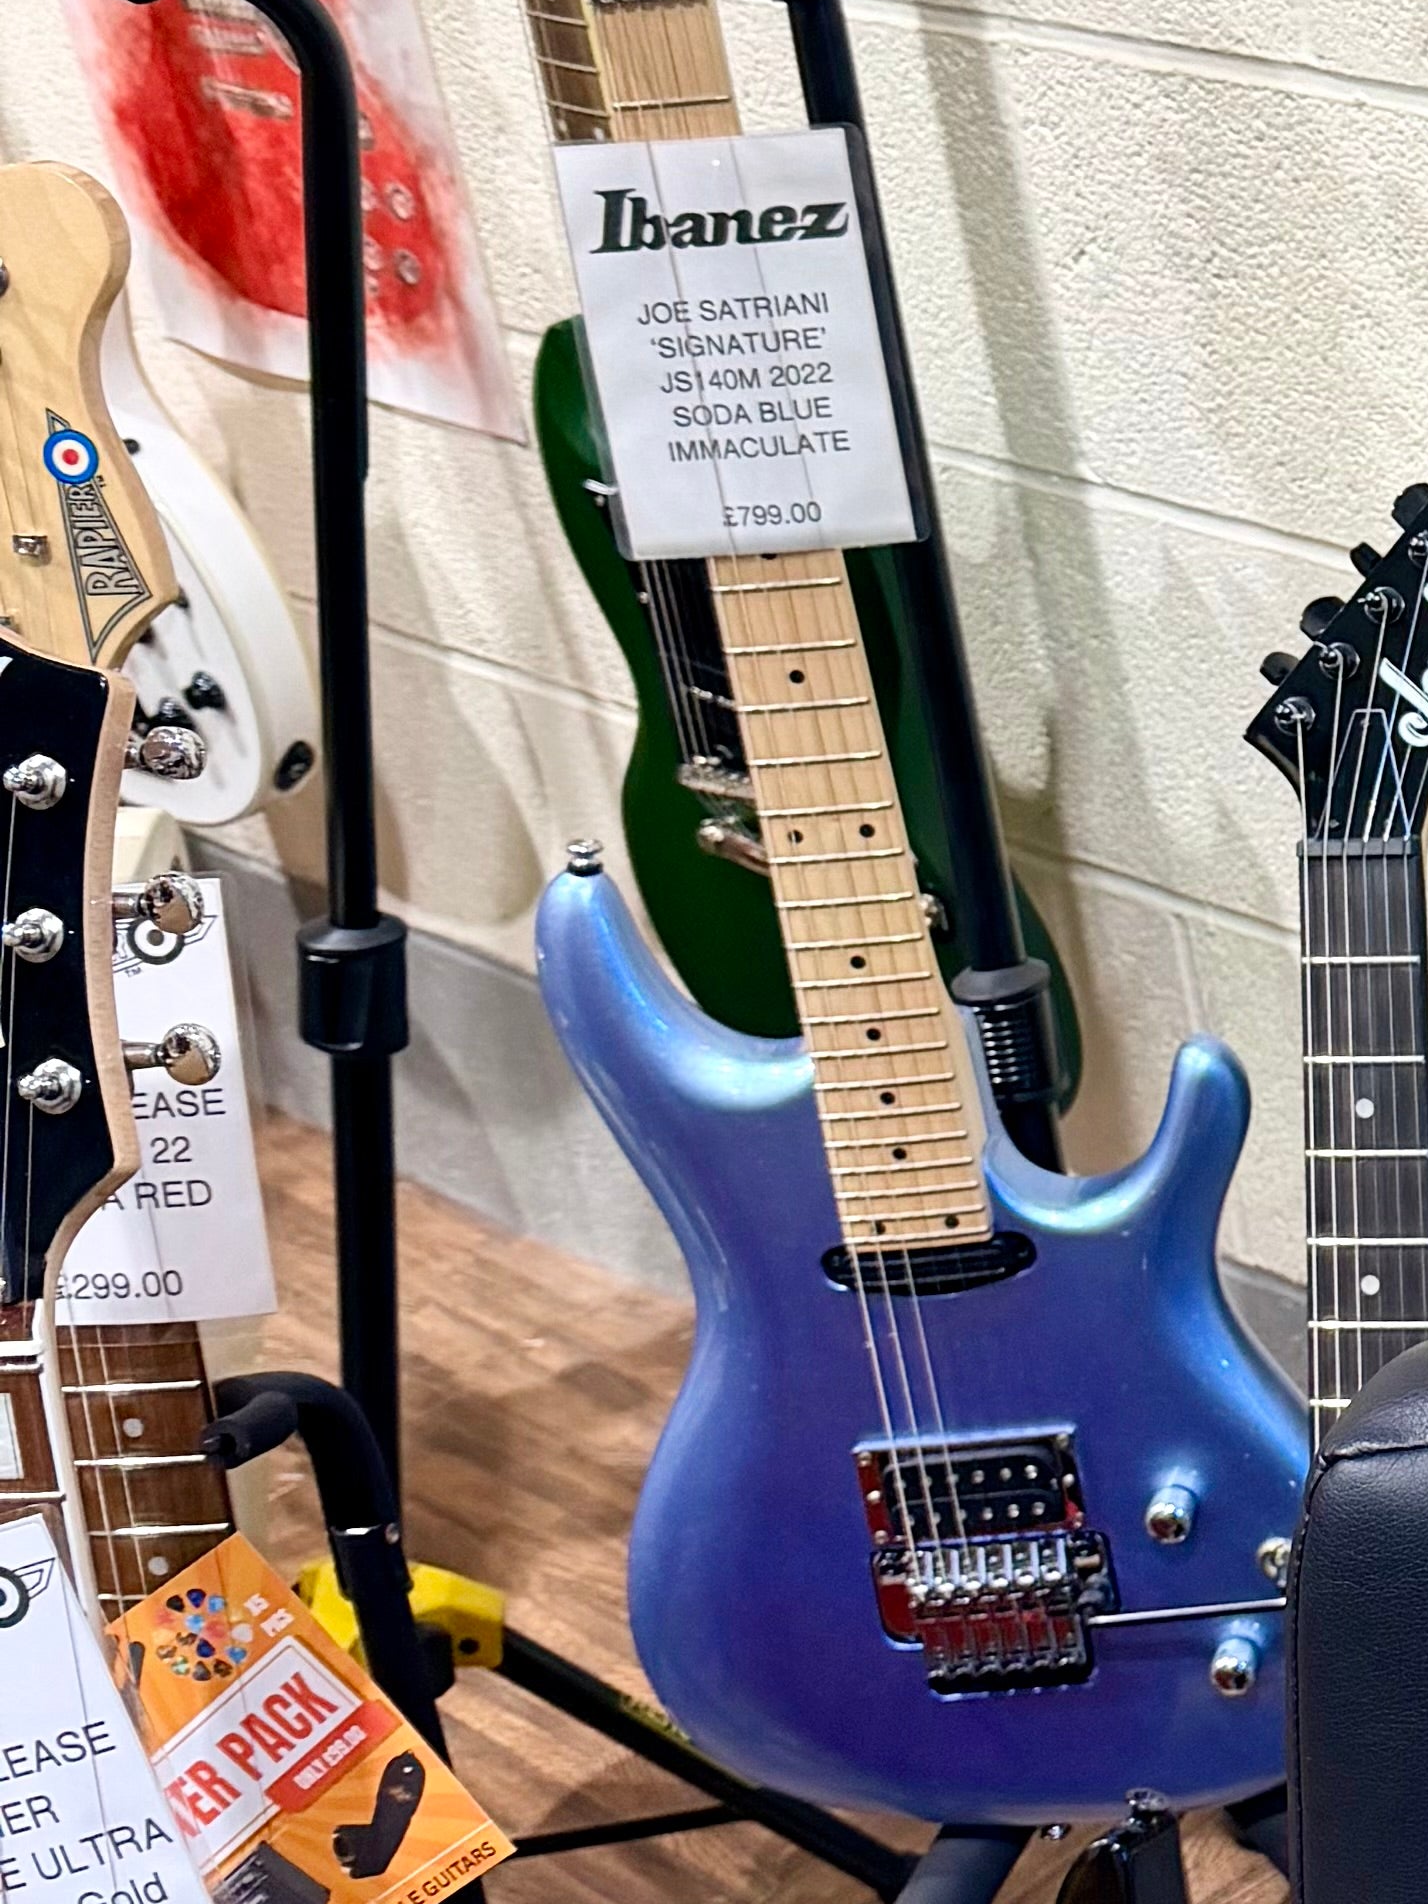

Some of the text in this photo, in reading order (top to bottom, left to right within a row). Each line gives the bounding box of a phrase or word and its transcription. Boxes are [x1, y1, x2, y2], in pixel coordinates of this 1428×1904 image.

[590, 188, 850, 254] Ibanez
[637, 292, 830, 326] JOE SATRIANI
[769, 362, 834, 388] 2022
[673, 396, 833, 428] SODA BLUE
[668, 429, 851, 463] IMMACULATE
[722, 501, 822, 528] £799.00
[66, 484, 145, 596] RAPIER
[150, 1136, 192, 1164] 22
[134, 1179, 212, 1209] RED
[216, 1672, 339, 1782] PACK
[0, 1795, 60, 1837] ER
[31, 1817, 174, 1880] ULTRA
[423, 1840, 498, 1897] GUITARS
